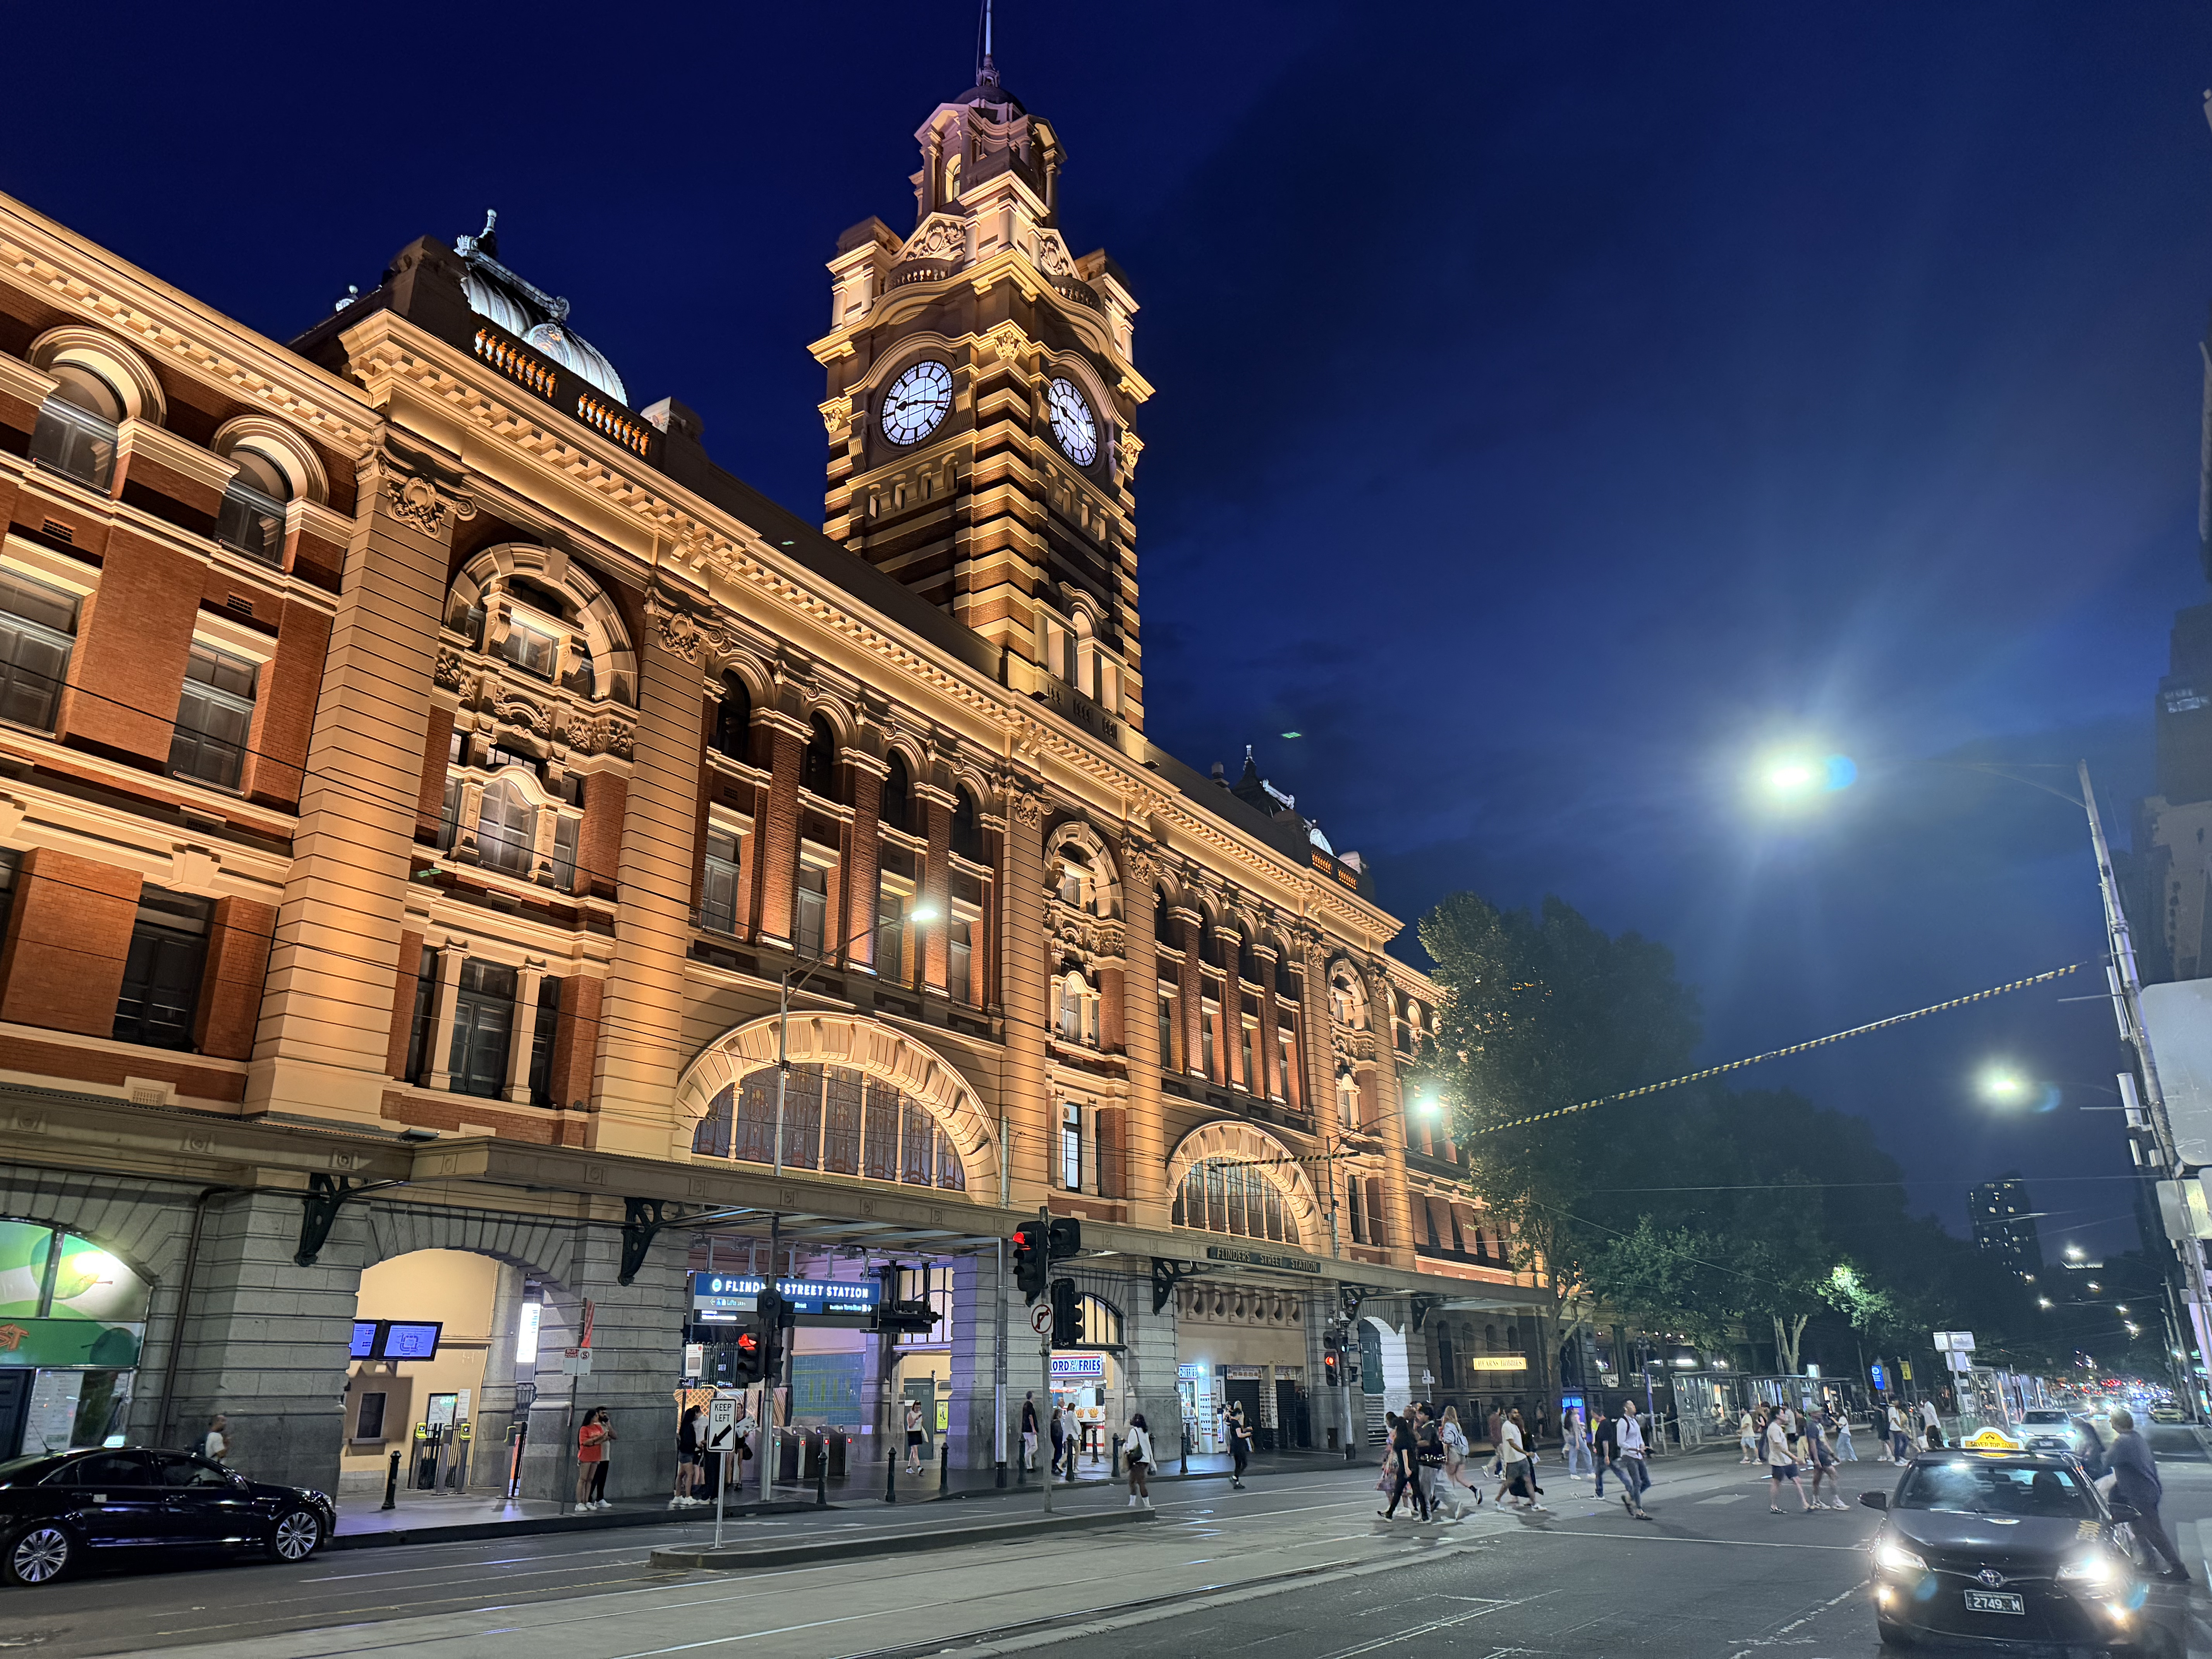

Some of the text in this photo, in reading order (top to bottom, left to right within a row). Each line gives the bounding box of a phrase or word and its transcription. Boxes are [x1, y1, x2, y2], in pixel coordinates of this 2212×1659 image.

[1217, 1248, 1317, 1272] FLINDERS STREET STATION
[784, 1283, 824, 1296] STREET
[826, 1286, 868, 1298] STATION
[1051, 1361, 1069, 1371] ORD
[1079, 1360, 1100, 1370] FRIES
[715, 1414, 730, 1422] LEFT
[1973, 1597, 2002, 1609] 2749
